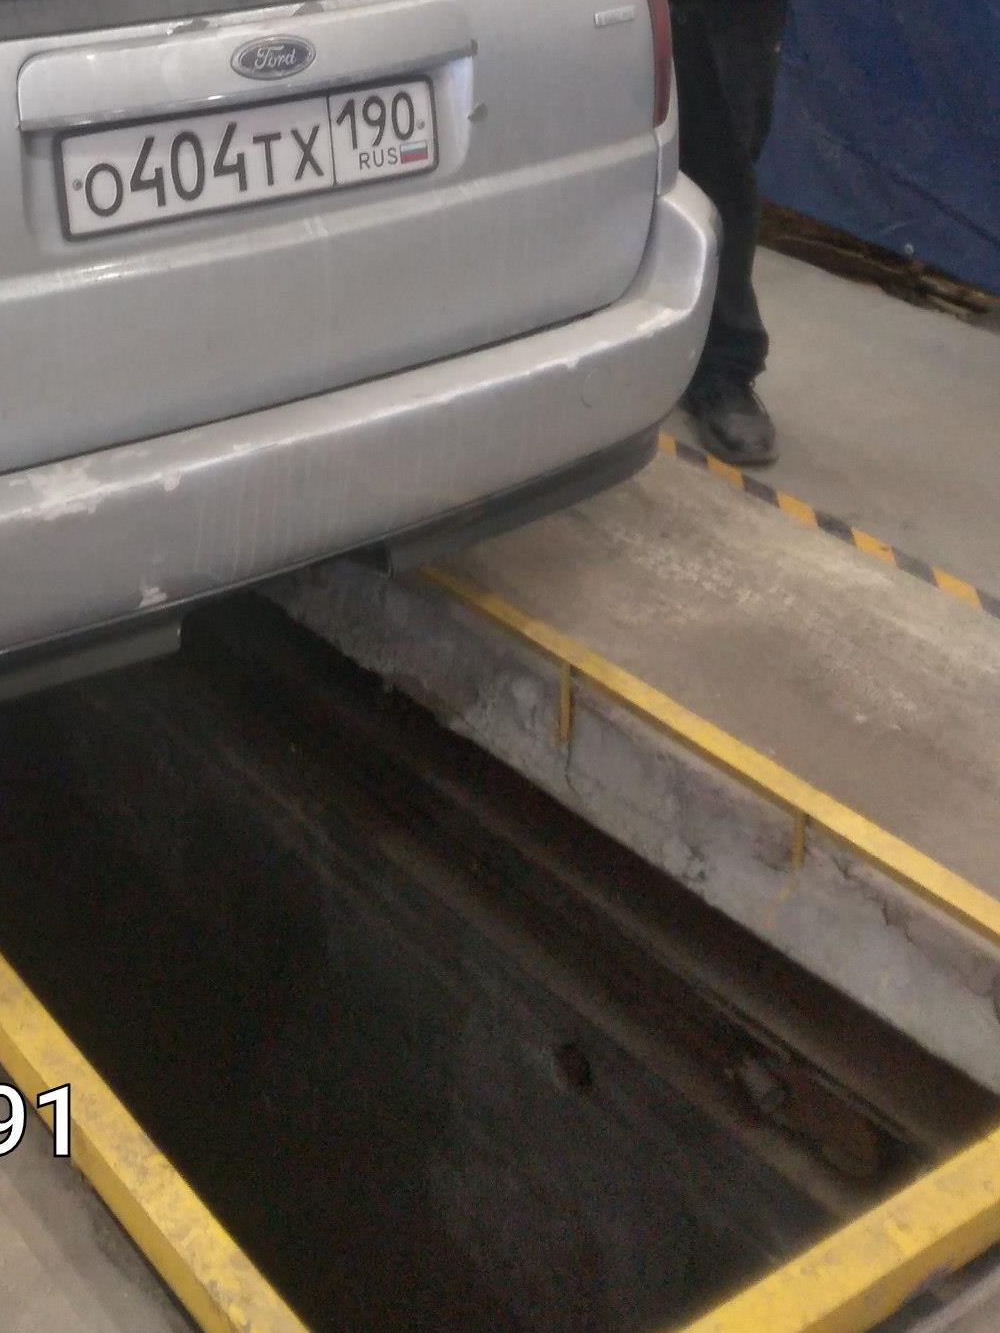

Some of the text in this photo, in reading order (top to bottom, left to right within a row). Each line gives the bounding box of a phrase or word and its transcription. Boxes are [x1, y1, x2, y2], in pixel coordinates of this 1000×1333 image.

[254, 44, 297, 68] Ford
[335, 91, 416, 151] 190
[358, 144, 399, 171] RUS
